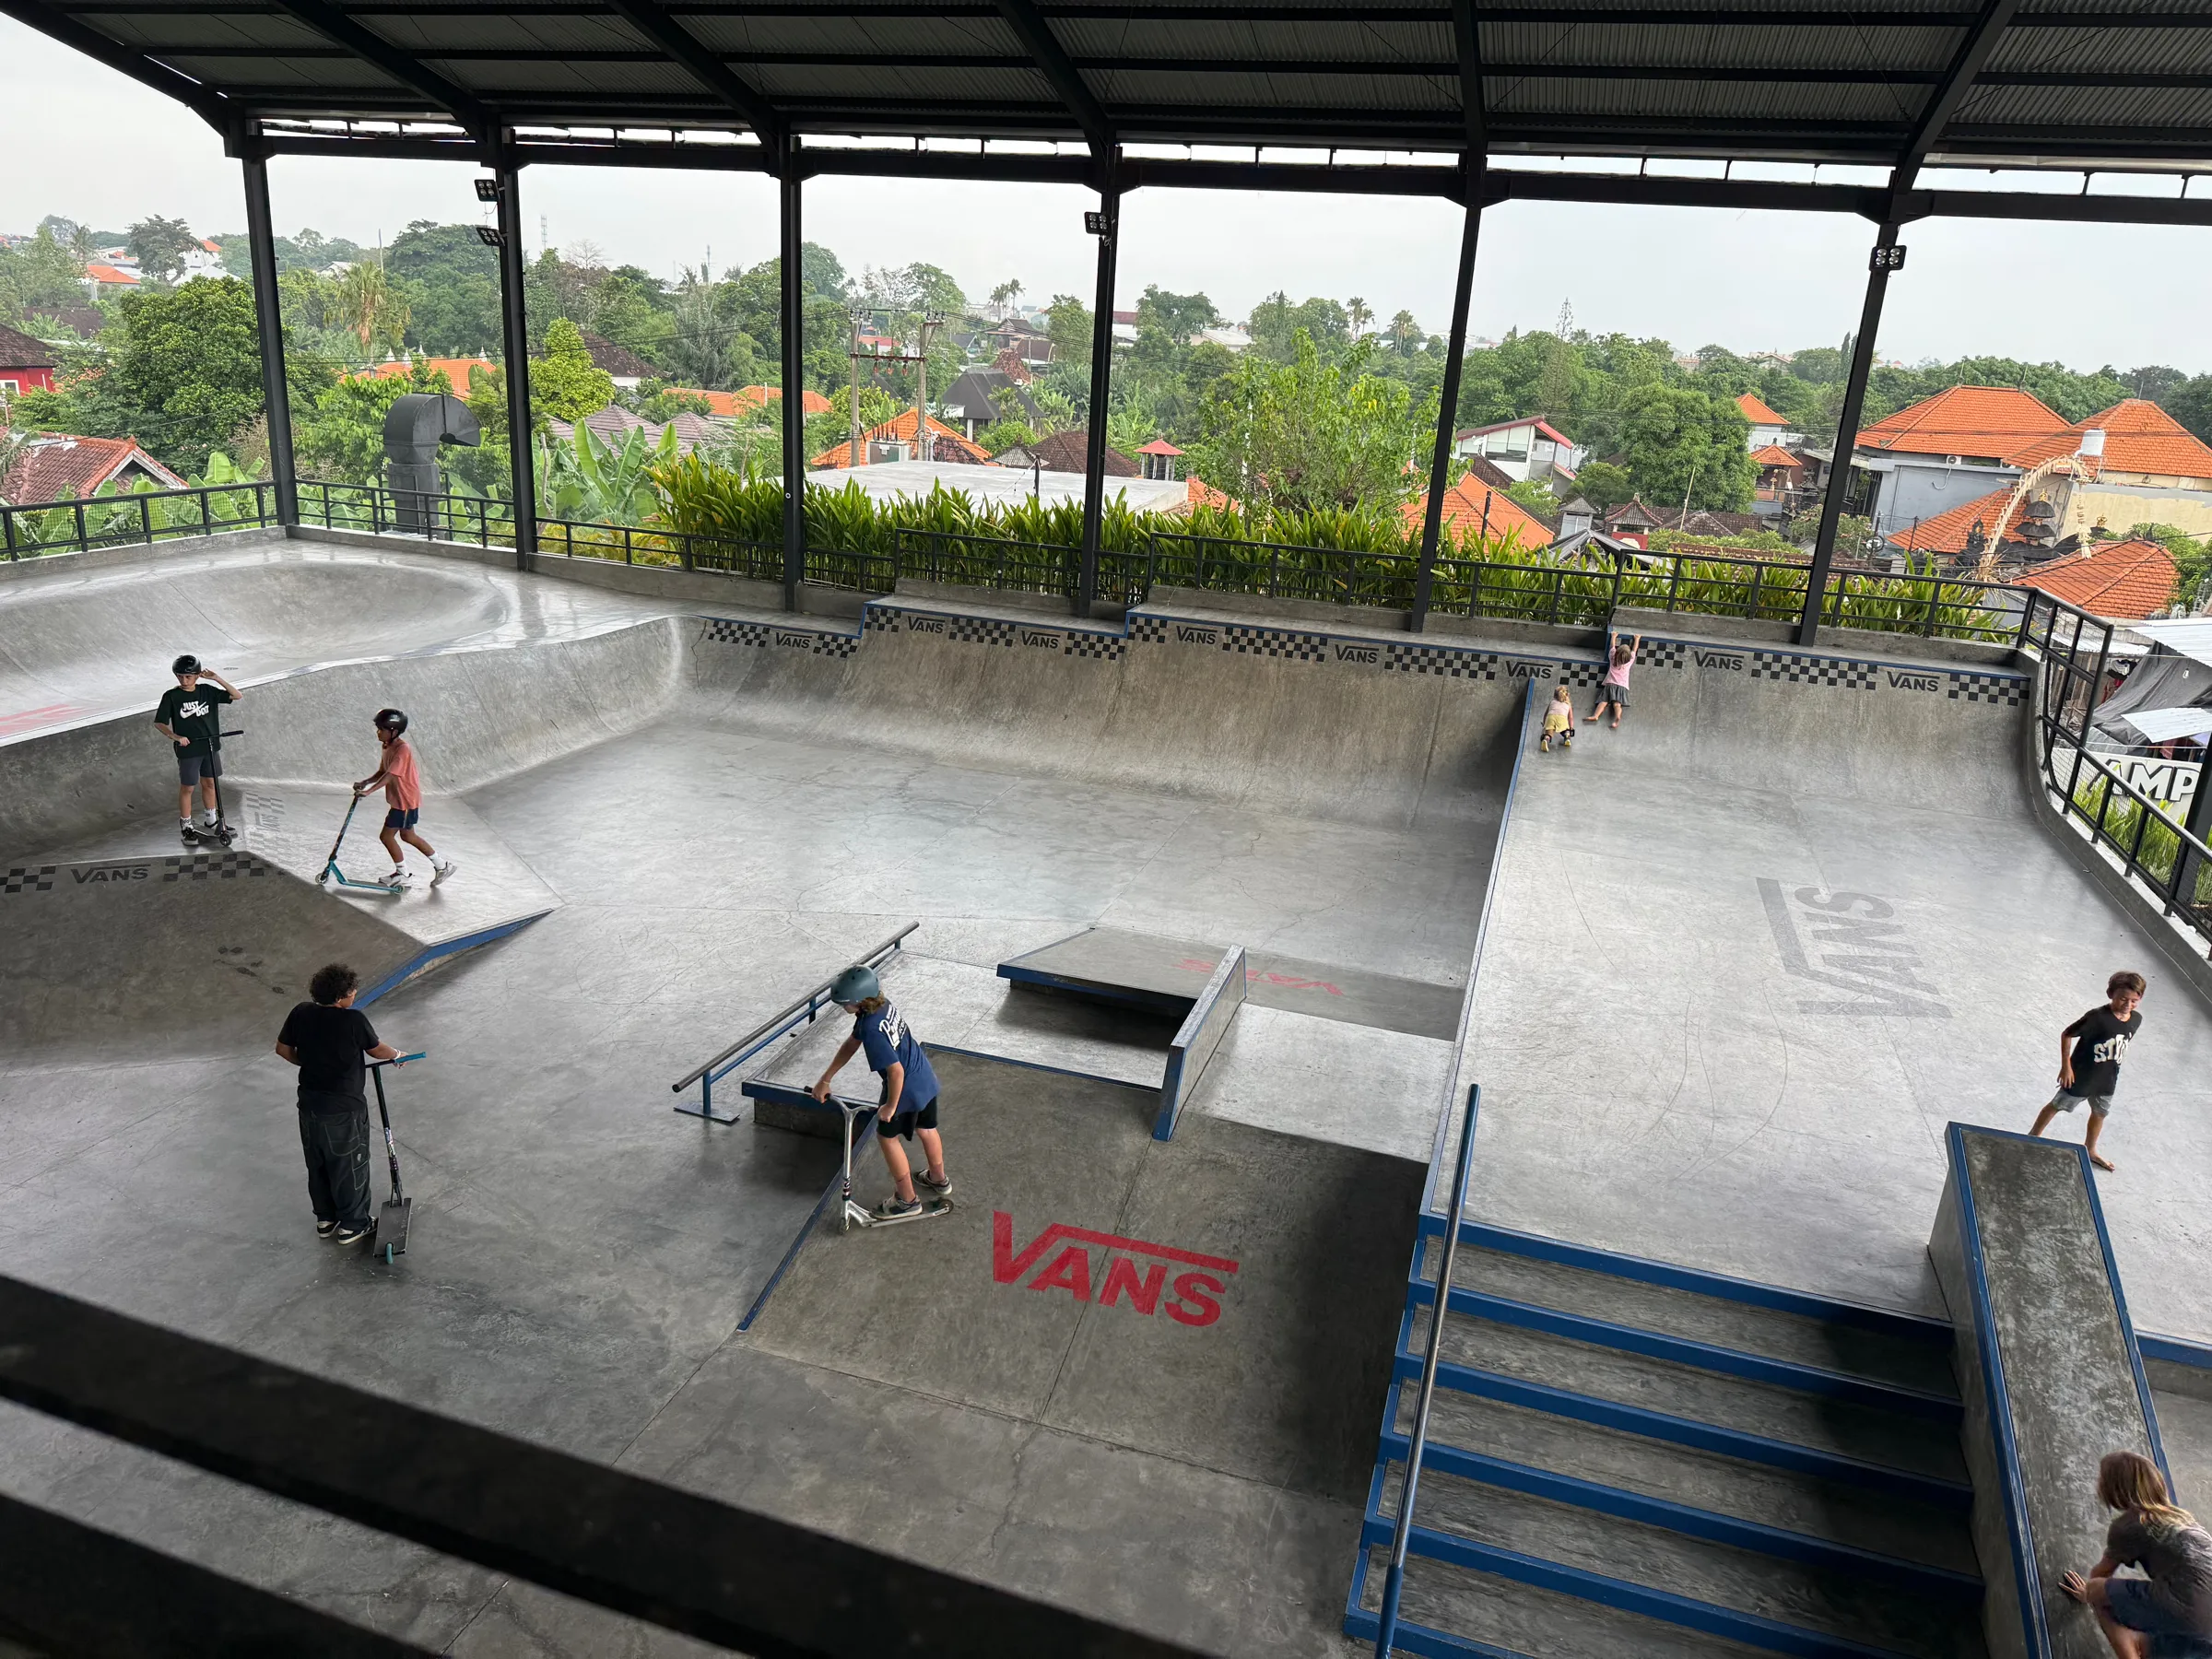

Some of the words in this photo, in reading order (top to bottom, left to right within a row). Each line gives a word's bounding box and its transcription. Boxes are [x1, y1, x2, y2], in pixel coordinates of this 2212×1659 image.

[908, 616, 946, 634] VANS
[1176, 625, 1218, 644] VANS
[776, 632, 813, 649] VANS
[1021, 630, 1061, 649] VANS
[1335, 644, 1379, 664] VANS
[1694, 650, 1744, 671] VANS
[1505, 660, 1553, 678] VANS
[1887, 671, 1940, 691] VANS
[182, 700, 198, 711] JUST
[71, 864, 151, 884] VANS
[1755, 877, 1953, 1018] VANS
[993, 1209, 1240, 1327] VANS
